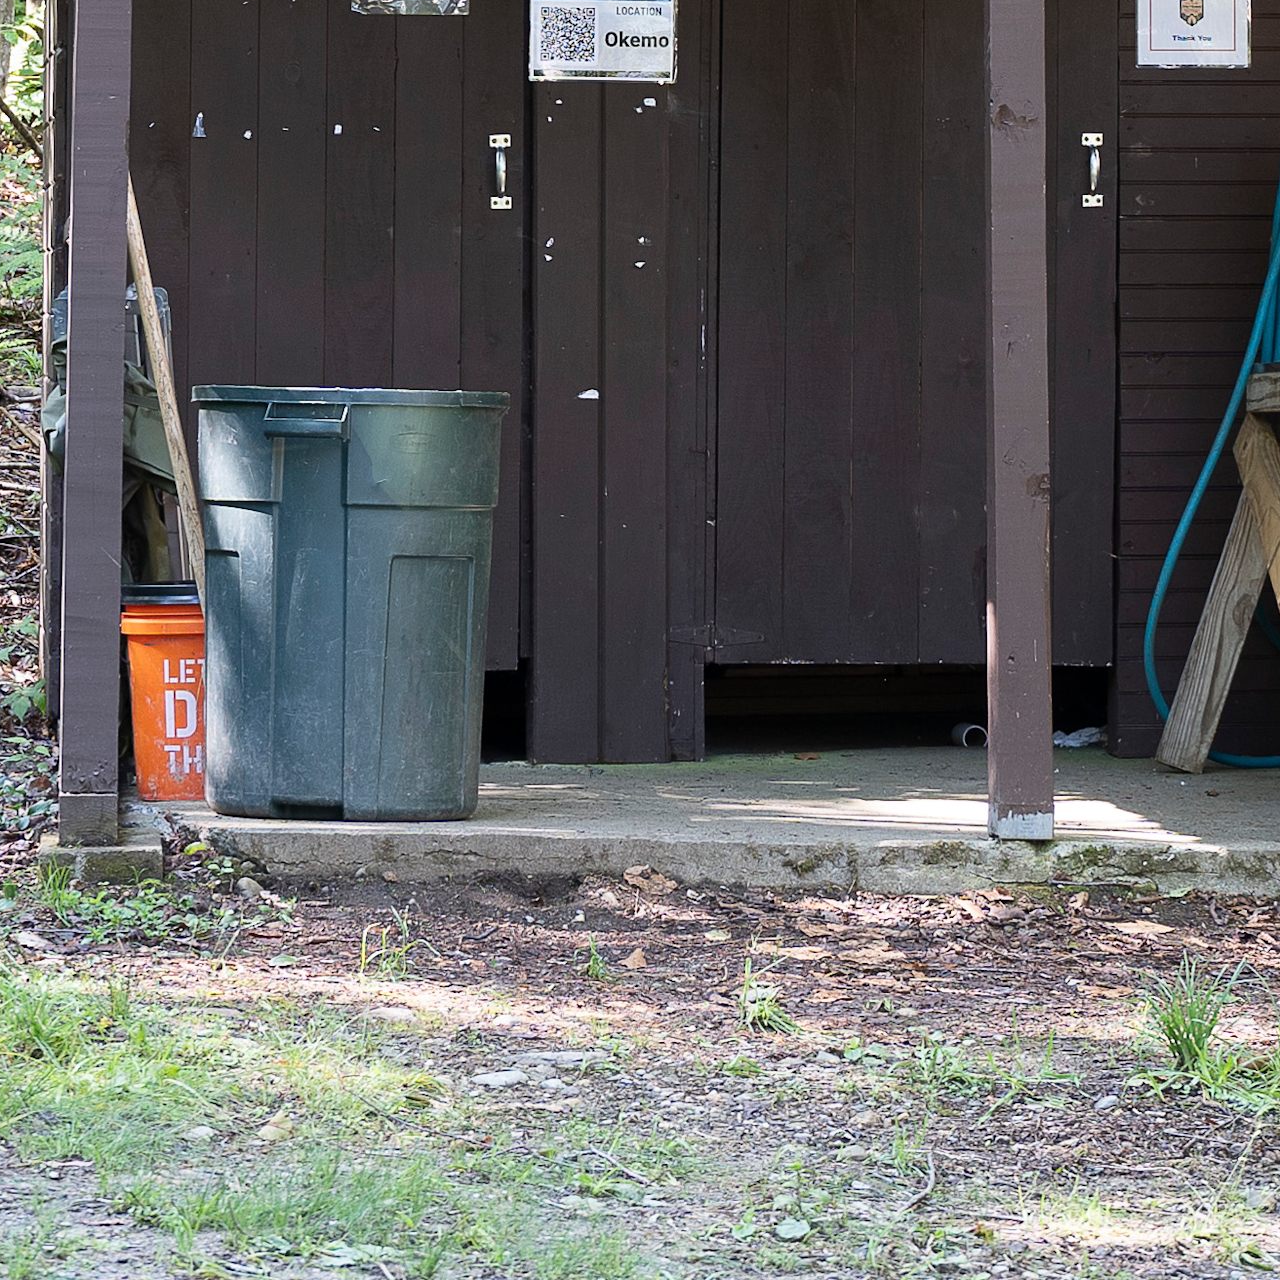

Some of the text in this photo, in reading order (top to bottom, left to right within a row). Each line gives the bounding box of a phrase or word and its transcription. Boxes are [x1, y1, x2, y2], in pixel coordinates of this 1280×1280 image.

[616, 6, 662, 16] LOCATION
[604, 31, 669, 48] Okemo
[164, 689, 205, 739] D
